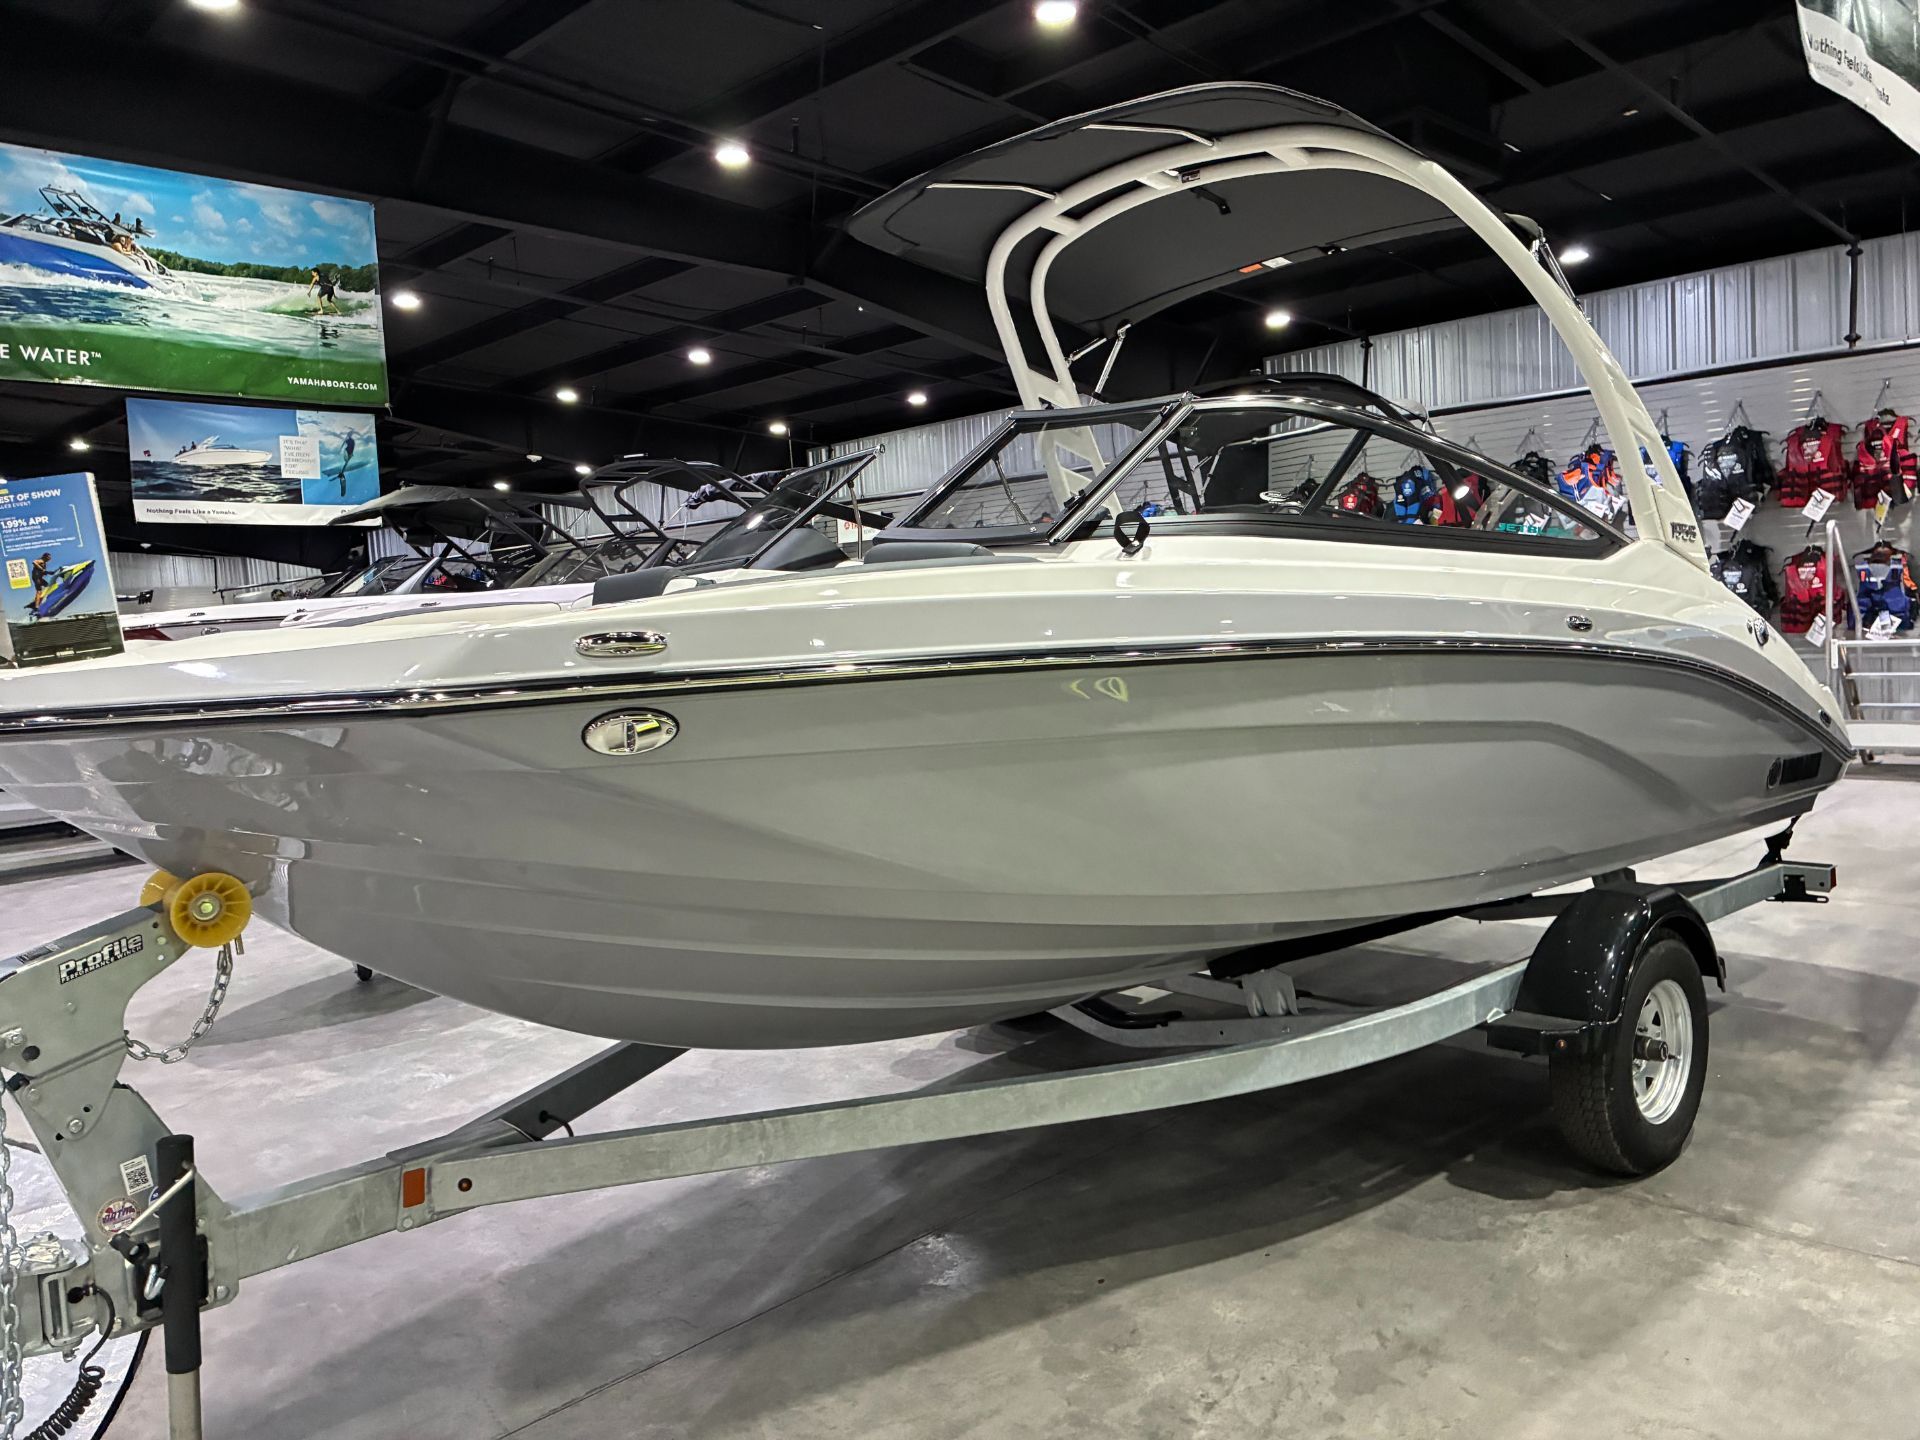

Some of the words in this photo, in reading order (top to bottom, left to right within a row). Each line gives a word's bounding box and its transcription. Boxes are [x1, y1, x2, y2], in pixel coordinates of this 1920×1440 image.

[287, 376, 378, 391] YAMAHABOATS.COM
[16, 492, 30, 501] OF
[31, 489, 61, 499] SHOW
[0, 518, 27, 529] 1.99%
[28, 515, 49, 526] APR
[60, 935, 142, 979] Profile
[60, 957, 115, 984] PERFORMANCE
[116, 945, 143, 960] WINCH
